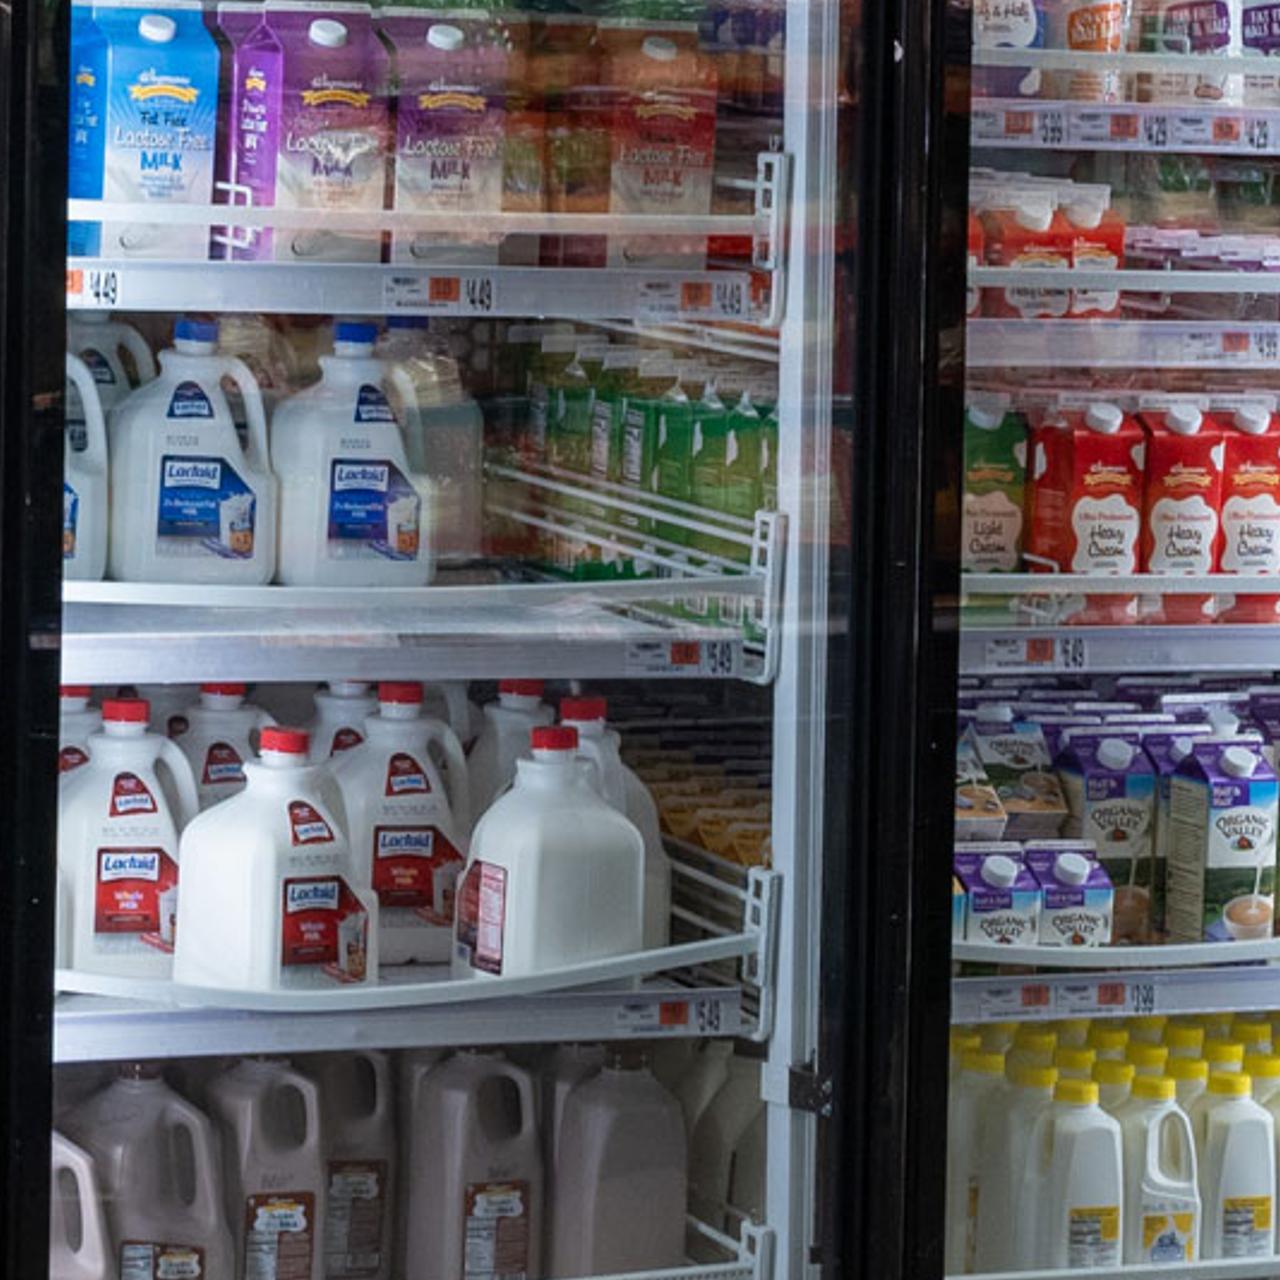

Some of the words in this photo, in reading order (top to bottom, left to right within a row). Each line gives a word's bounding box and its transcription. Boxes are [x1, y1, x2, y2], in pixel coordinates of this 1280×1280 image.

[140, 110, 159, 126] Fat
[163, 111, 187, 127] Free
[113, 125, 175, 149] Lactose
[177, 127, 212, 151] Free
[403, 136, 462, 159] Lactose
[465, 137, 497, 160] Free
[140, 150, 183, 171] MILK
[430, 160, 471, 180] MILK
[167, 462, 219, 482] Lactaid
[337, 466, 386, 484] Lactaid
[973, 521, 1003, 539] Light
[1090, 524, 1125, 546] Heavy
[1167, 524, 1203, 546] Heavy
[1237, 523, 1273, 543] Heavy
[970, 539, 1006, 555] Cream
[1087, 539, 1126, 558] Cream
[1165, 539, 1203, 558] Cream
[1237, 539, 1275, 556] Cream
[1215, 812, 1269, 830] ORGANIC
[380, 831, 432, 851] Lactaid
[103, 854, 158, 874] Lactaid
[289, 884, 338, 904] Lactaid
